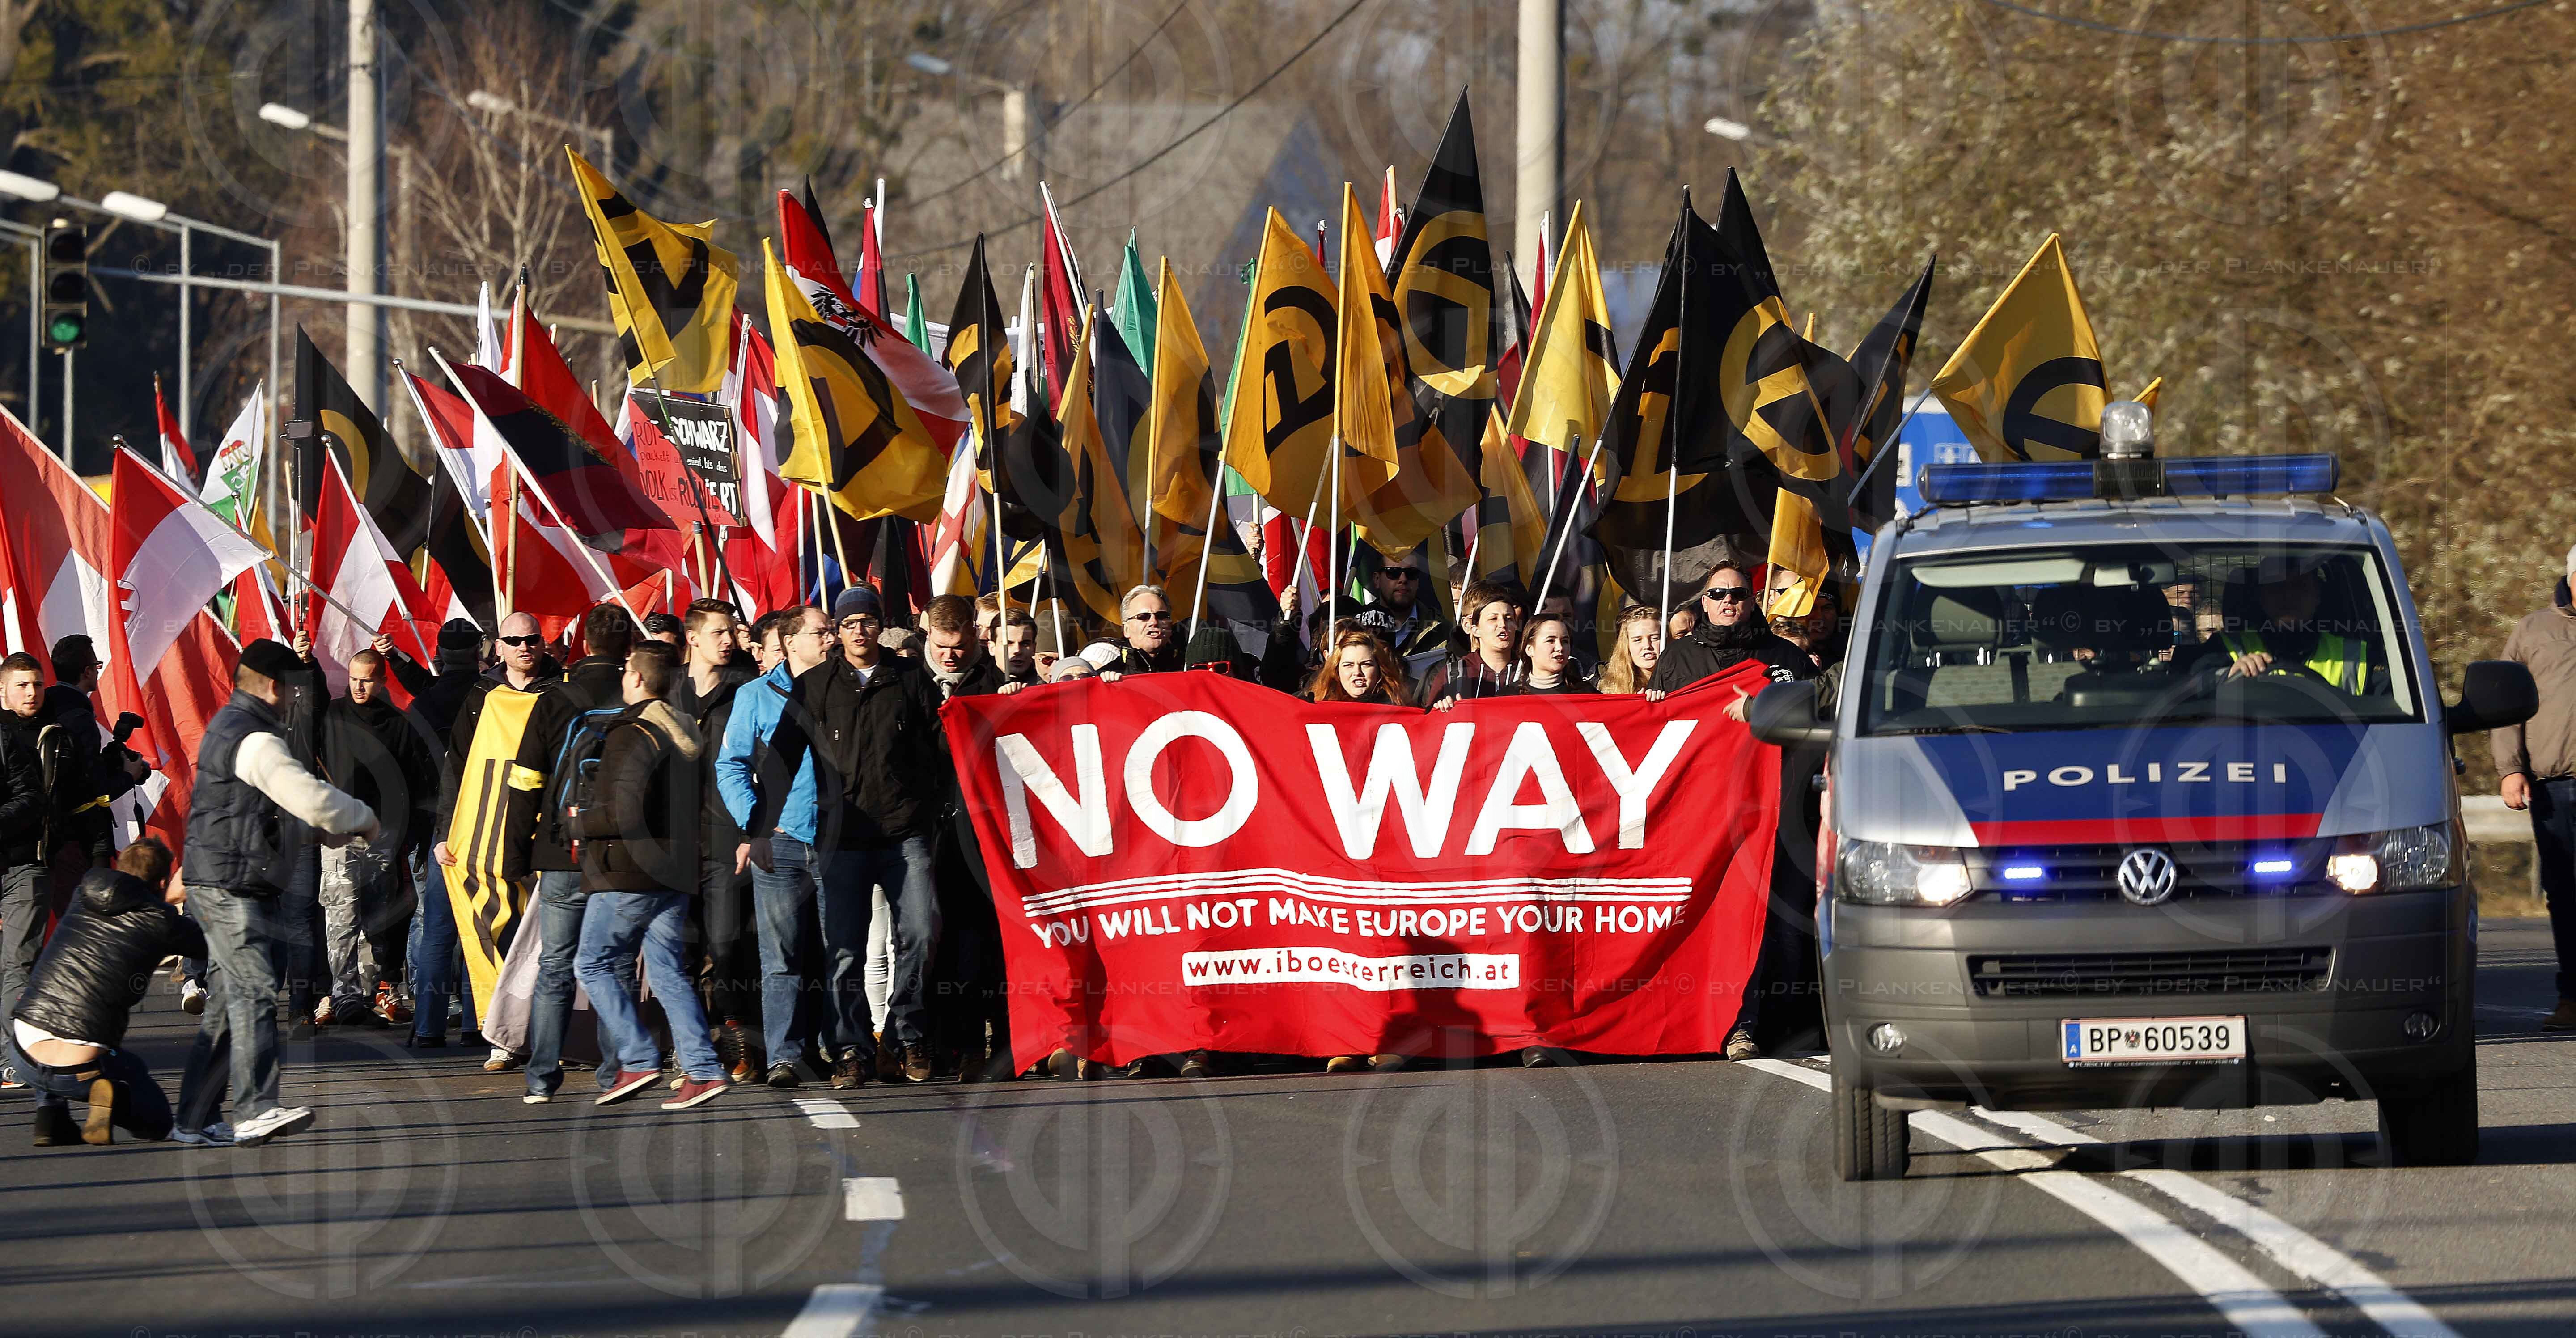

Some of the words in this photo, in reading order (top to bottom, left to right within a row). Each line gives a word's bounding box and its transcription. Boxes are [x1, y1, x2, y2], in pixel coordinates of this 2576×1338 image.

[640, 469, 669, 501] VOLK
[995, 710, 1259, 869] NO
[1305, 719, 1699, 860] WAY
[2003, 762, 2287, 791] POLIZEI
[1030, 915, 1089, 949] YOU
[1098, 905, 1181, 940] WILL
[1186, 898, 1258, 931] NOT
[1268, 897, 1350, 934] MAKE
[1356, 907, 1487, 938] EUROPE
[1496, 904, 1583, 934] YOUR
[1595, 904, 1689, 934] HOME
[1187, 950, 1510, 982] www.iboesterreich.at
[2069, 1045, 2078, 1054] A
[2089, 1028, 2121, 1053] BP
[2145, 1025, 2230, 1051] 60539
